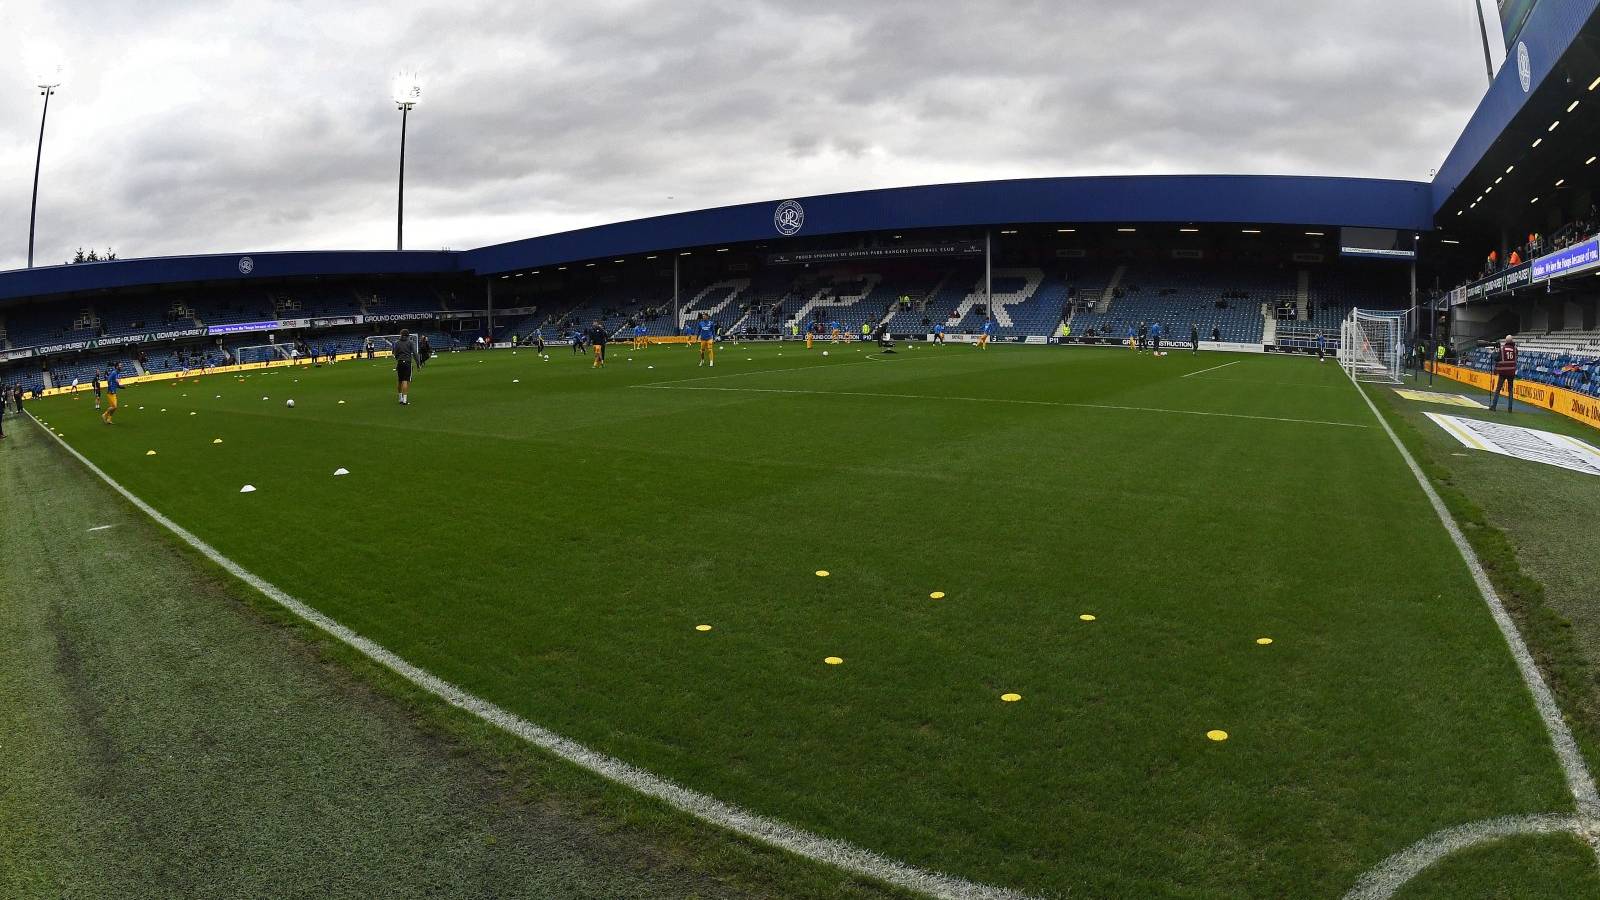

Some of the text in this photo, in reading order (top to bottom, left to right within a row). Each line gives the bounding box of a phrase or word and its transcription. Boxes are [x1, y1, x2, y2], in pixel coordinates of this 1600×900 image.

[364, 314, 390, 322] GROUND
[390, 312, 433, 321] CONSTRUCTION
[1147, 340, 1192, 348] COSTRUCTION
